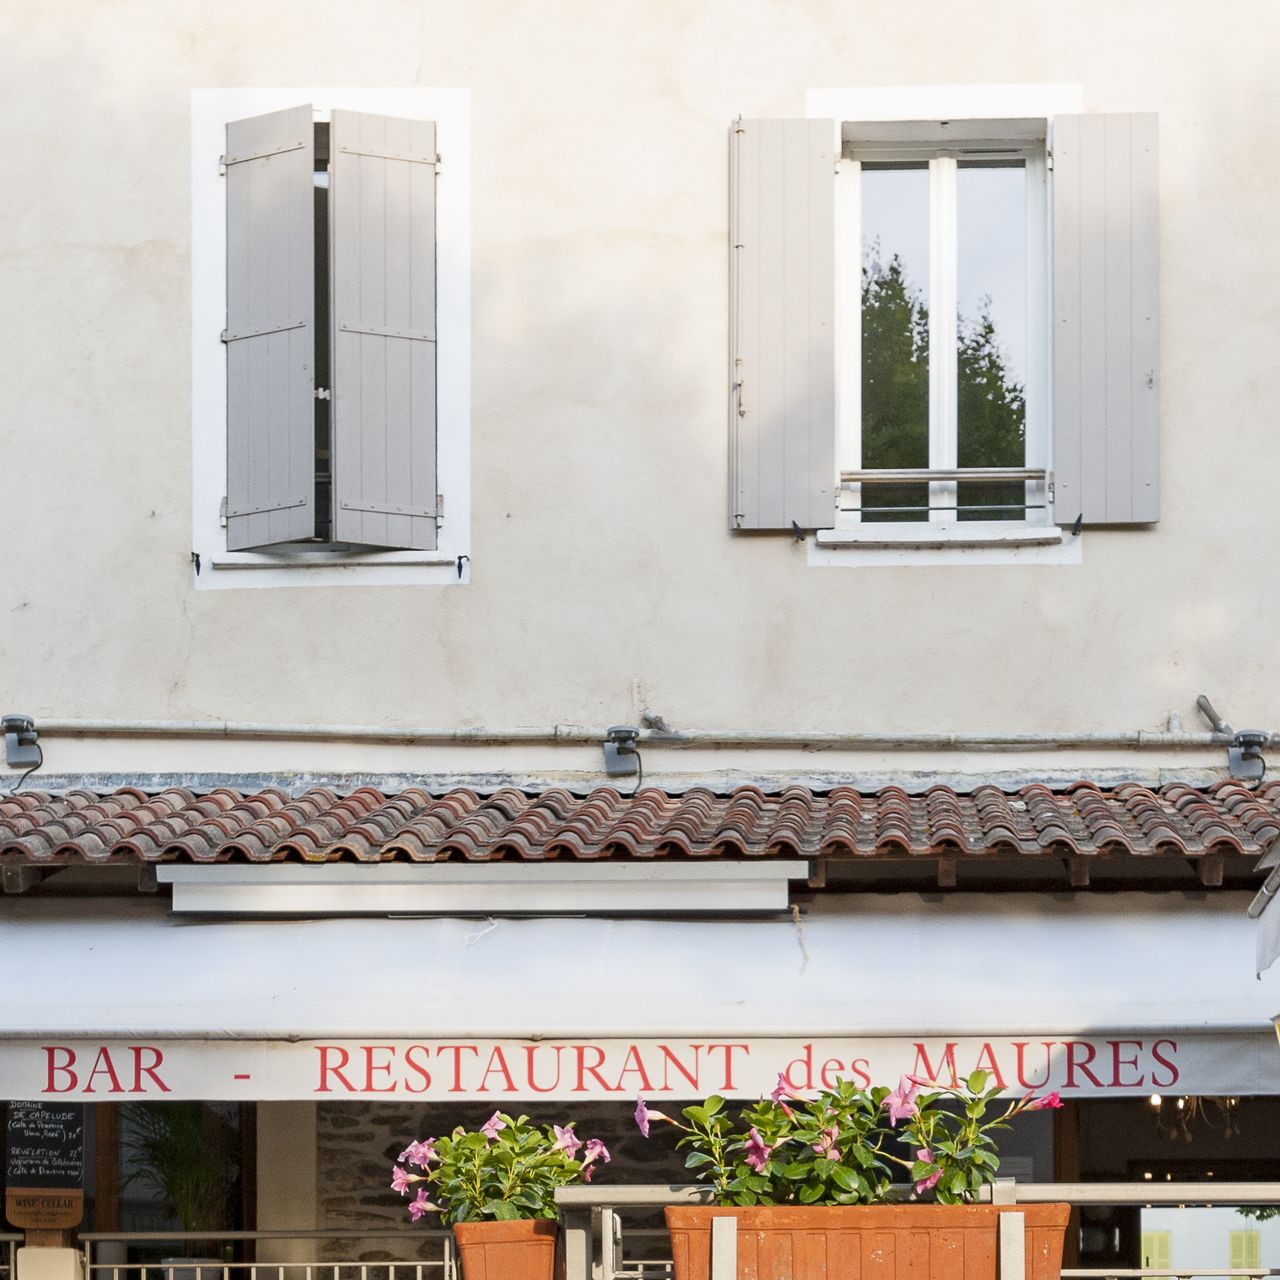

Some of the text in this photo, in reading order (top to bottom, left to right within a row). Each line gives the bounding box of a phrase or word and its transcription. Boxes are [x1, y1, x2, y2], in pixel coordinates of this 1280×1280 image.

[41, 1045, 172, 1093] BAR
[313, 1044, 750, 1093] RESTAURANT
[785, 1044, 872, 1091] des
[912, 1039, 1180, 1090] MAURES
[15, 1198, 73, 1208] WINE CELLAR
